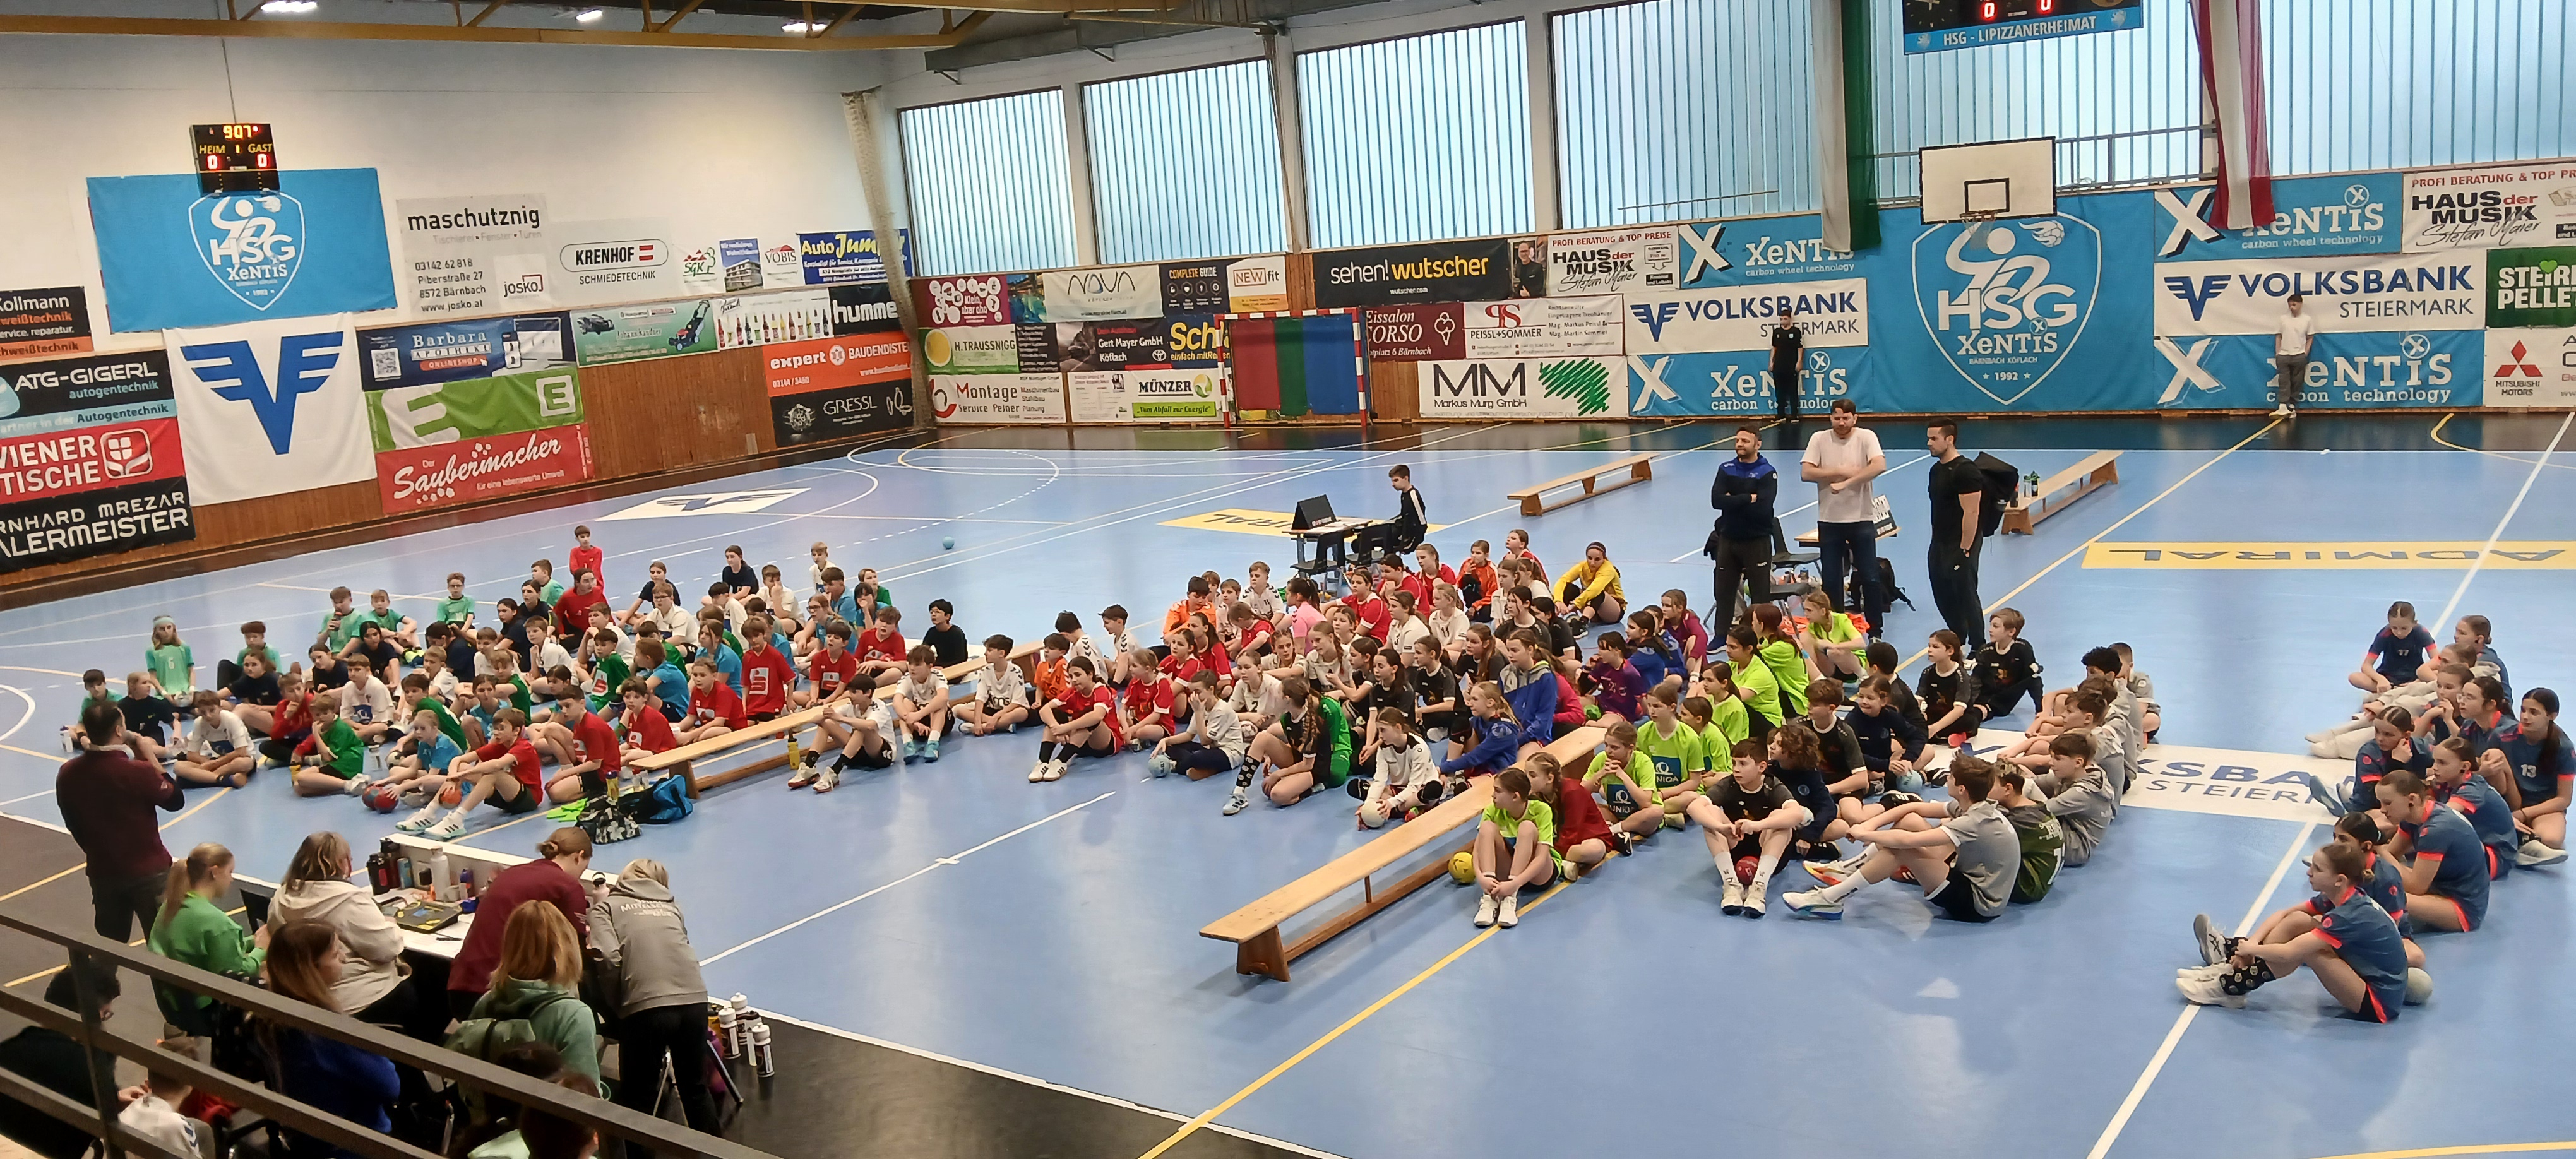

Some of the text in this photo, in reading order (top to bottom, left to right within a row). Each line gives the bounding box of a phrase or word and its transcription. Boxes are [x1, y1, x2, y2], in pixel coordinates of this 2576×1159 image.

[1943, 16, 2097, 46] HSG LIPIZZANERHEIMAT
[199, 143, 273, 154] HEIM GAST
[206, 153, 268, 169] 0 0
[2412, 177, 2445, 188] PROFI
[2450, 174, 2513, 186] BERATUNG
[2519, 172, 2527, 181] &
[2531, 170, 2556, 181] TOP
[2412, 191, 2539, 211] HAUS der
[407, 205, 540, 232] maschutznig
[2431, 205, 2538, 225] MUSIK
[1577, 235, 1616, 245] BERATUNG
[1645, 231, 1672, 240] PREISE
[2241, 234, 2383, 249] carbon wheel technology
[2416, 222, 2486, 247] Stefan
[210, 234, 296, 266] HSG
[801, 240, 835, 256] Auto
[414, 258, 474, 271] 03142 62 818
[575, 246, 635, 268] KRENHOF
[765, 251, 797, 264] VOBIS
[1553, 249, 1612, 264] HAUS
[1611, 251, 1635, 259] der
[1169, 266, 1218, 280] COMPLETE GUIDE
[1330, 255, 1489, 285] sehen! wutscher
[1566, 259, 1635, 275] MUSIK
[1746, 263, 1855, 276] carbon wheel technology
[473, 271, 484, 282] 27
[579, 271, 657, 285] SCHMIEDETECHNIK
[1067, 271, 1136, 295] NOVA
[1236, 270, 1280, 283] NEW fit
[1558, 273, 1602, 292] Stefan
[2238, 264, 2474, 298] VOLKSBANK
[419, 288, 442, 299] 8572
[503, 280, 539, 298] josko
[1390, 286, 1428, 295] wutscher.com
[1685, 291, 1859, 321] VOLKSBANK
[2497, 287, 2576, 310] PELLE
[1938, 283, 2077, 331] HSG
[2339, 298, 2474, 318] STEIERMARK
[0, 311, 73, 327] weißtechnik
[1366, 309, 1415, 324] Eissalon
[0, 328, 30, 338] ervice.
[412, 331, 487, 348] Barbara
[1470, 328, 1542, 340] PEISSL+SOMMER
[954, 340, 1016, 352] H.TRAUSSNIGG
[1098, 336, 1164, 350] Gert Mayer GmbH
[1957, 329, 2058, 355] XeNTiS
[1099, 352, 1128, 362] Köflach
[1171, 350, 1196, 361] einfach
[1398, 346, 1432, 356] Bärnbach
[428, 357, 477, 369] ONLINESHOP
[770, 352, 827, 369] expert
[14, 361, 159, 392] ATG-GIGERL
[1433, 362, 1527, 397] MM
[1994, 371, 2019, 381] 1992
[68, 379, 160, 400] autogentechnik
[955, 381, 1018, 403] Montage
[1138, 379, 1193, 393] MÜNZER
[2501, 388, 2534, 396] MOTORS
[1434, 398, 1527, 409] Markus Murg GmbH
[2344, 388, 2452, 404] technology
[823, 396, 878, 415] GRESSL
[1710, 399, 1758, 410] carbon
[0, 420, 38, 434] artner
[76, 403, 169, 424] Autogentechnik
[393, 432, 563, 500] Saubermacher
[0, 459, 102, 497] TISCHE
[98, 491, 186, 519] MREZAR
[2109, 547, 2567, 562] ADMIRAL
[2520, 764, 2537, 778] 13
